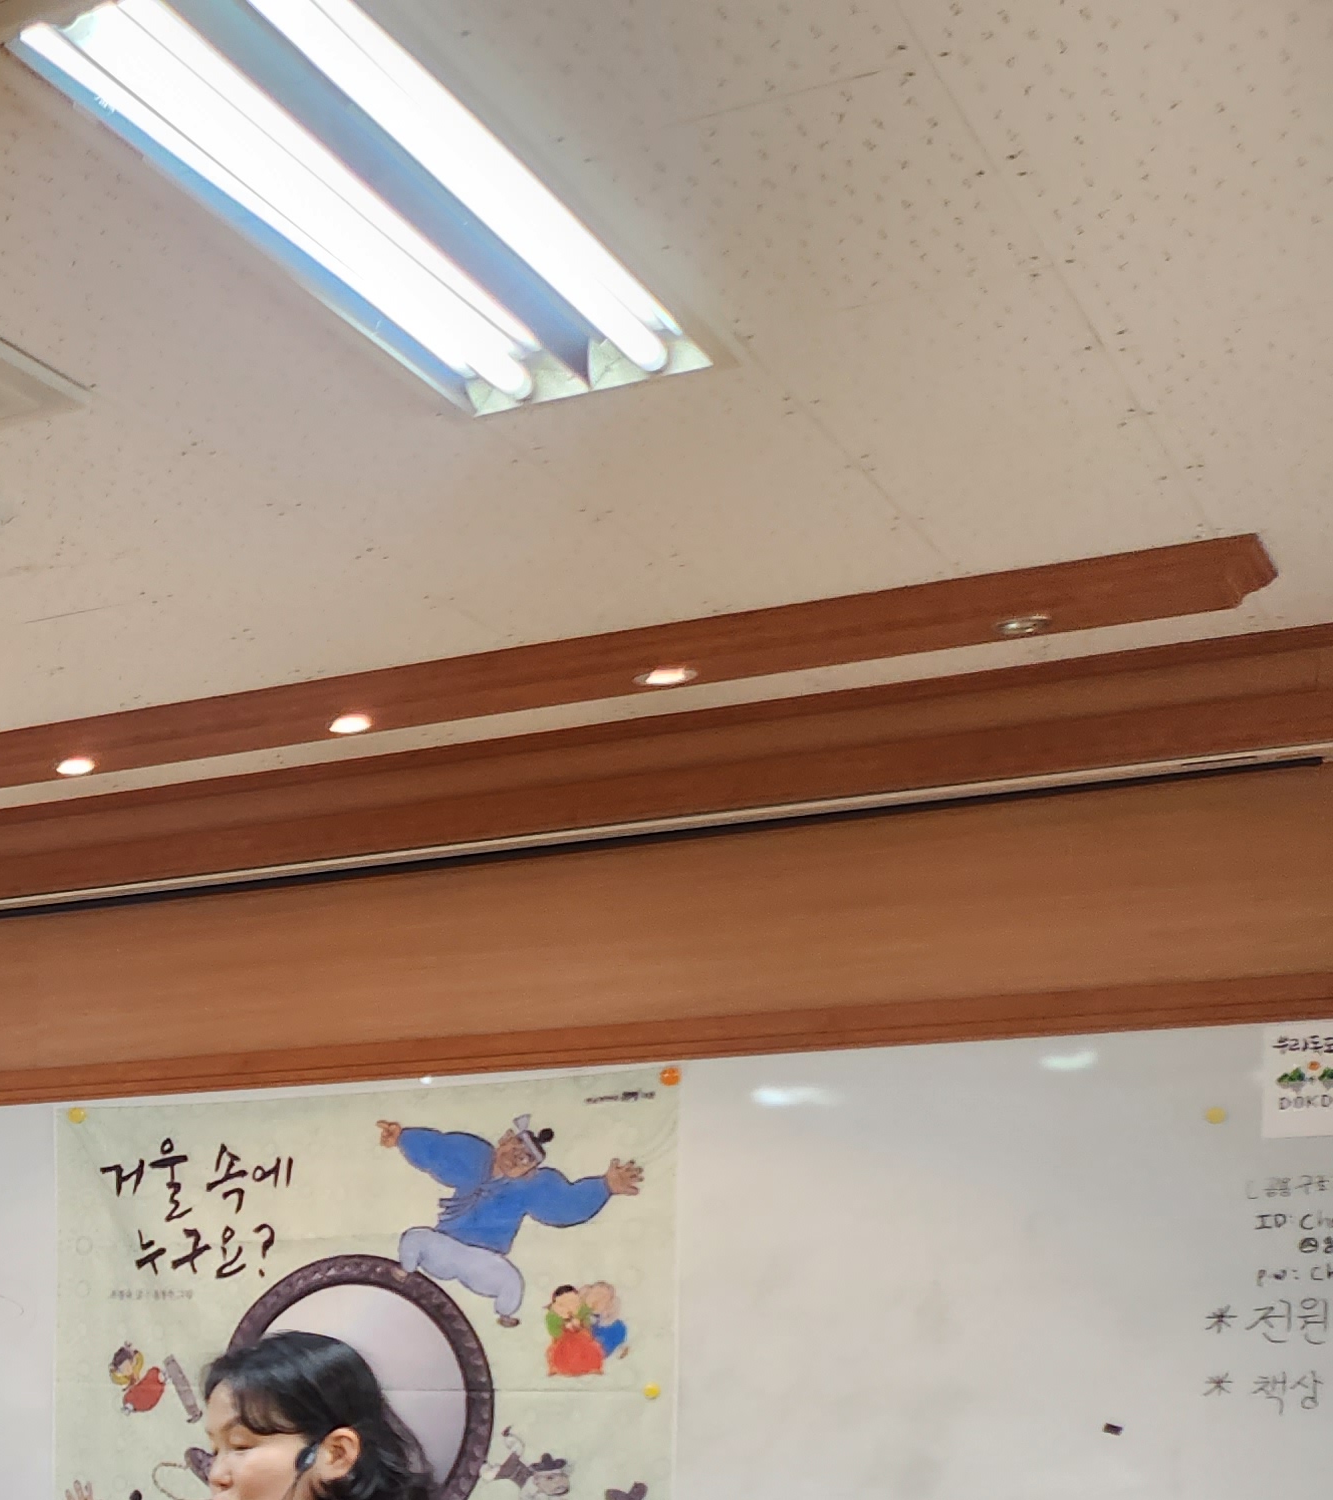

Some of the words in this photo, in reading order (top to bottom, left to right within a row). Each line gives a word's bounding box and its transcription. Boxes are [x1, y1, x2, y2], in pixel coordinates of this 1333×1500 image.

[99, 1137, 193, 1223] 거울
[206, 1143, 294, 1214] 속에
[135, 1223, 276, 1279] 누구요?
